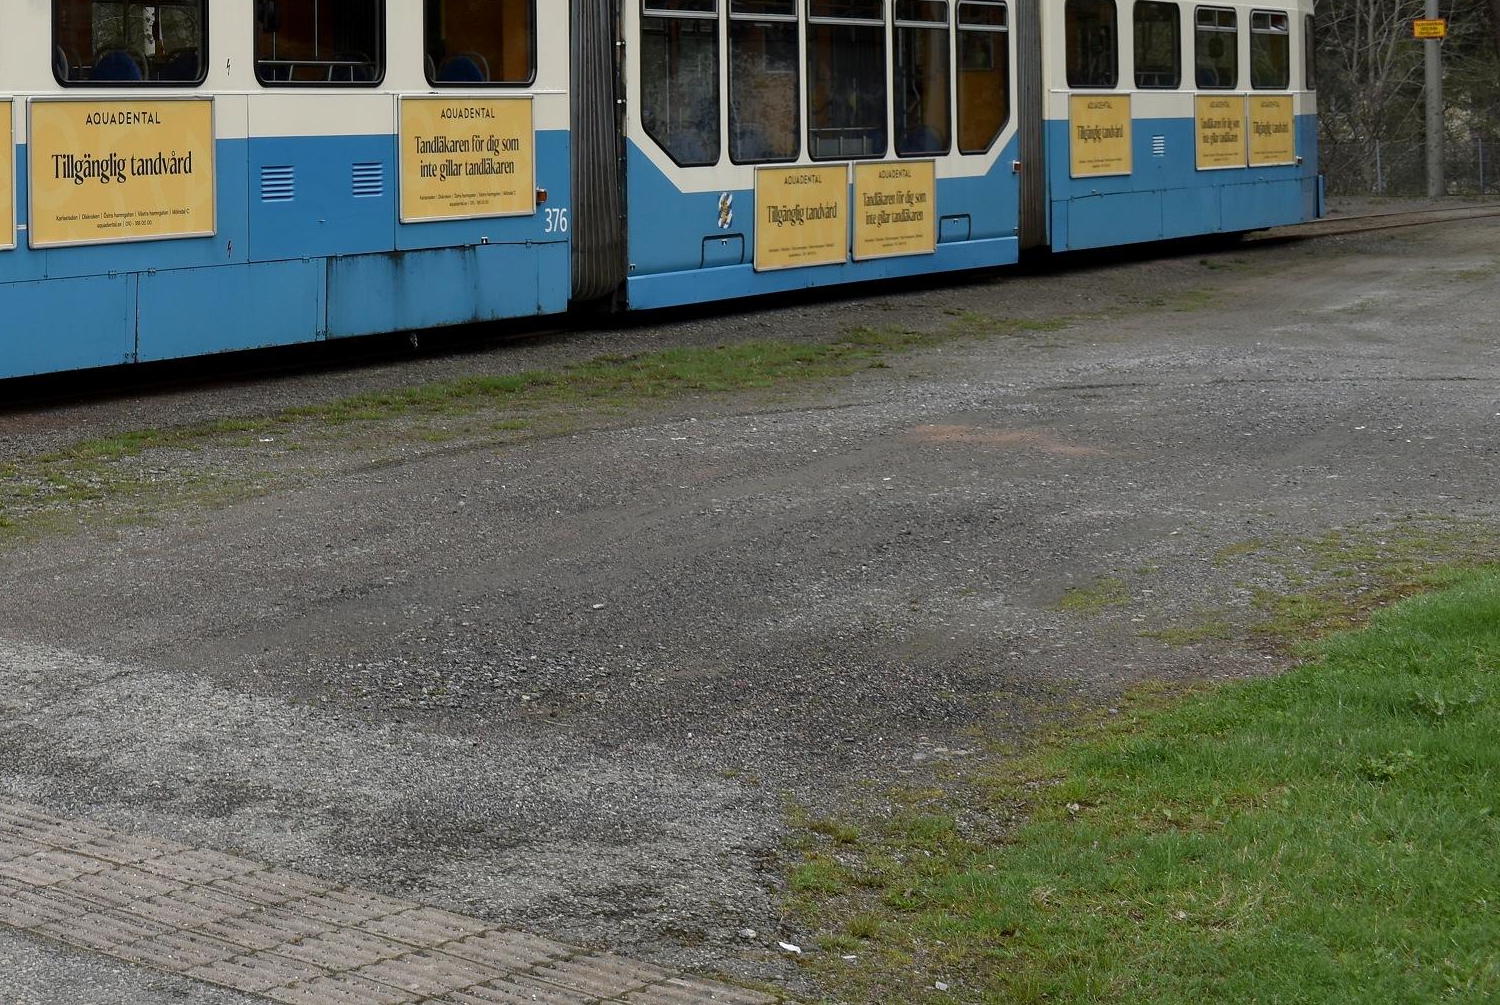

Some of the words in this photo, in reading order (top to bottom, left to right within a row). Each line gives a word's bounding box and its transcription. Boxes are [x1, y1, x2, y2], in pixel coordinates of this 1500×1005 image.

[85, 111, 161, 125] AQUADENTAL
[441, 107, 495, 119] AQUADENTAL
[414, 135, 470, 154] Tandläkaren
[472, 135, 484, 152] för
[487, 134, 500, 156] dig
[502, 137, 519, 151] som
[51, 152, 127, 185] Tillgänglig
[131, 150, 192, 176] tandvård
[420, 161, 437, 178] inte
[439, 159, 463, 181] gillar
[465, 158, 514, 175] tandläkaren
[784, 175, 822, 185] AQUADENTAL
[545, 208, 568, 233] 376
